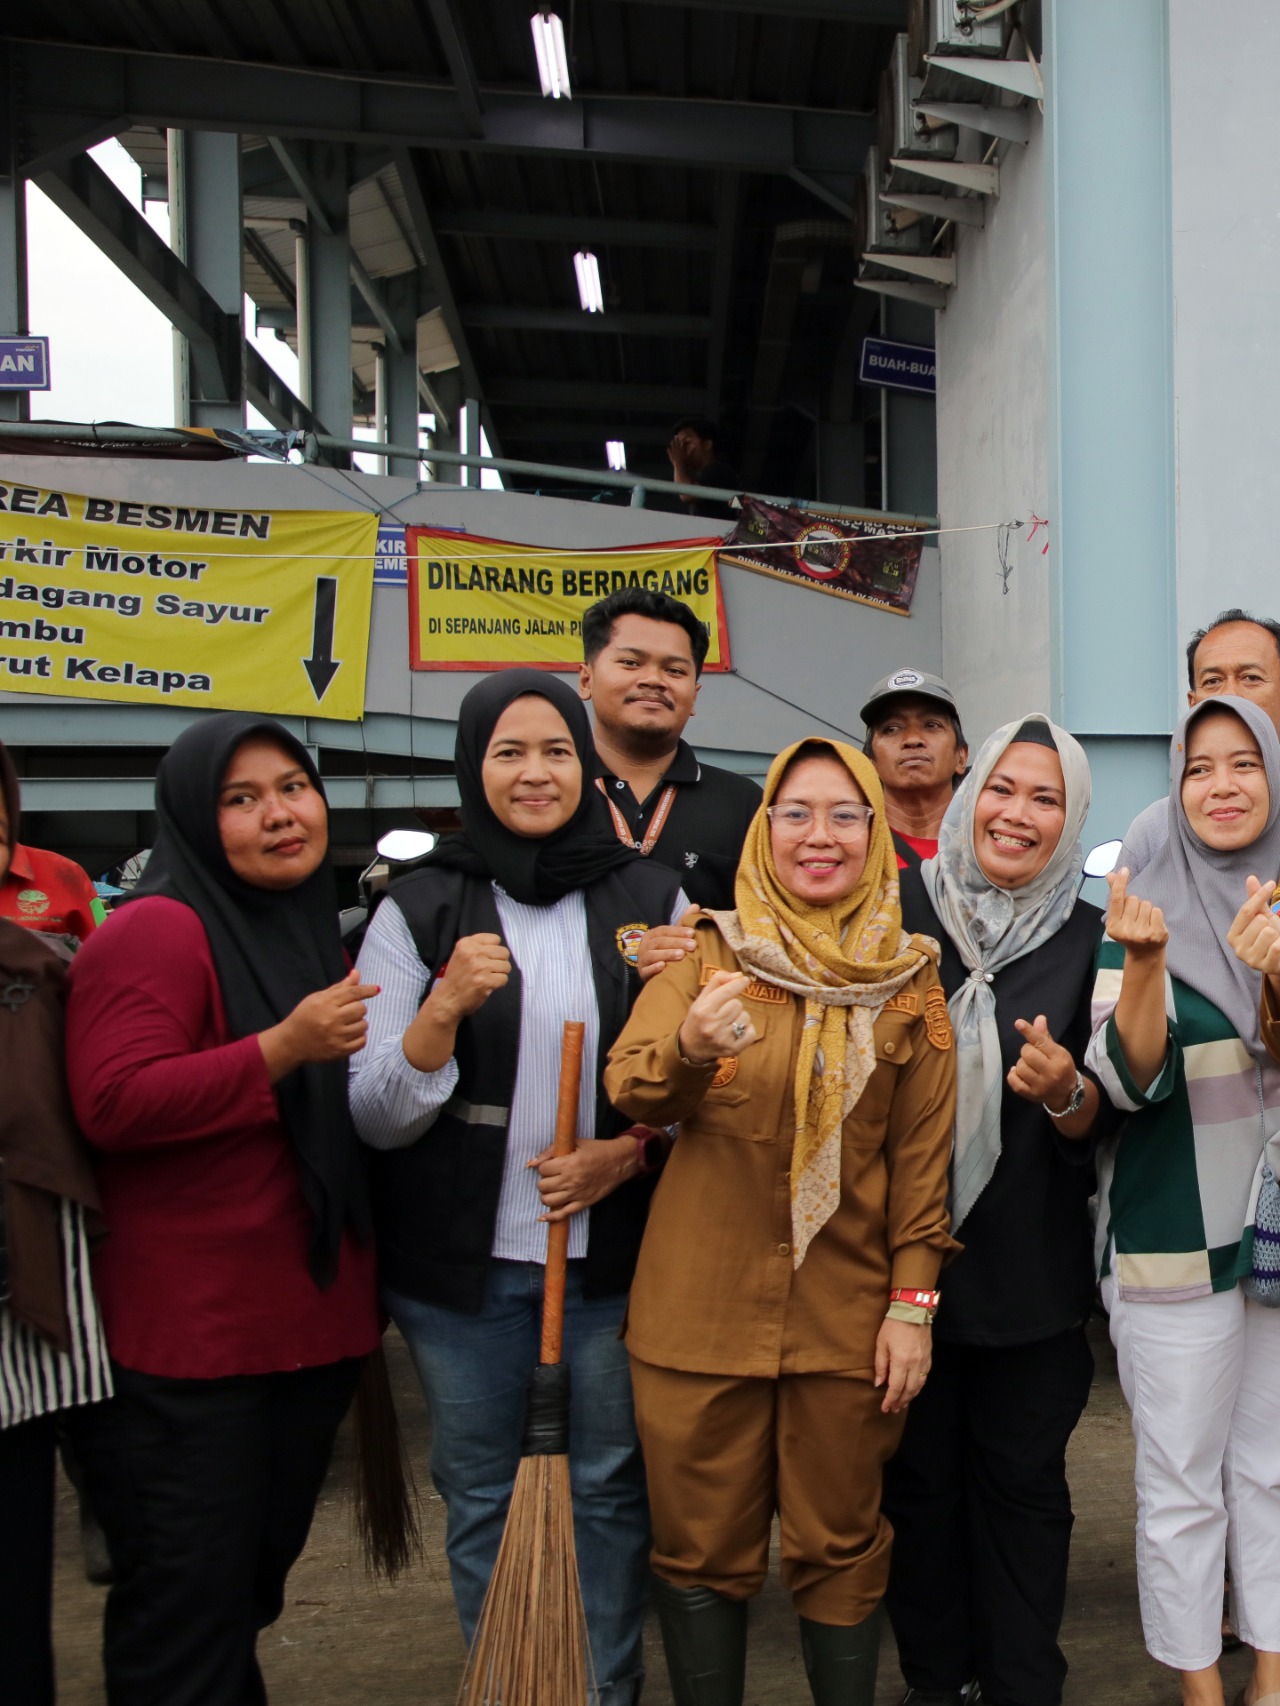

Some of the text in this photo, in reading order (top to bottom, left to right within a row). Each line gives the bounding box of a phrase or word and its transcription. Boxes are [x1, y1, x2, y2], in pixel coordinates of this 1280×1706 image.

[0, 354, 35, 372] AN
[85, 498, 270, 539] BESMEN
[86, 545, 207, 580] Motor
[427, 562, 709, 597] DILARANG BERDAGANG
[155, 594, 270, 624] Sayur
[428, 617, 441, 634] DI
[446, 617, 520, 636] SEPANJANG
[525, 618, 564, 636] JALAN
[66, 657, 211, 693] Kelapa
[743, 983, 782, 1000] WATI
